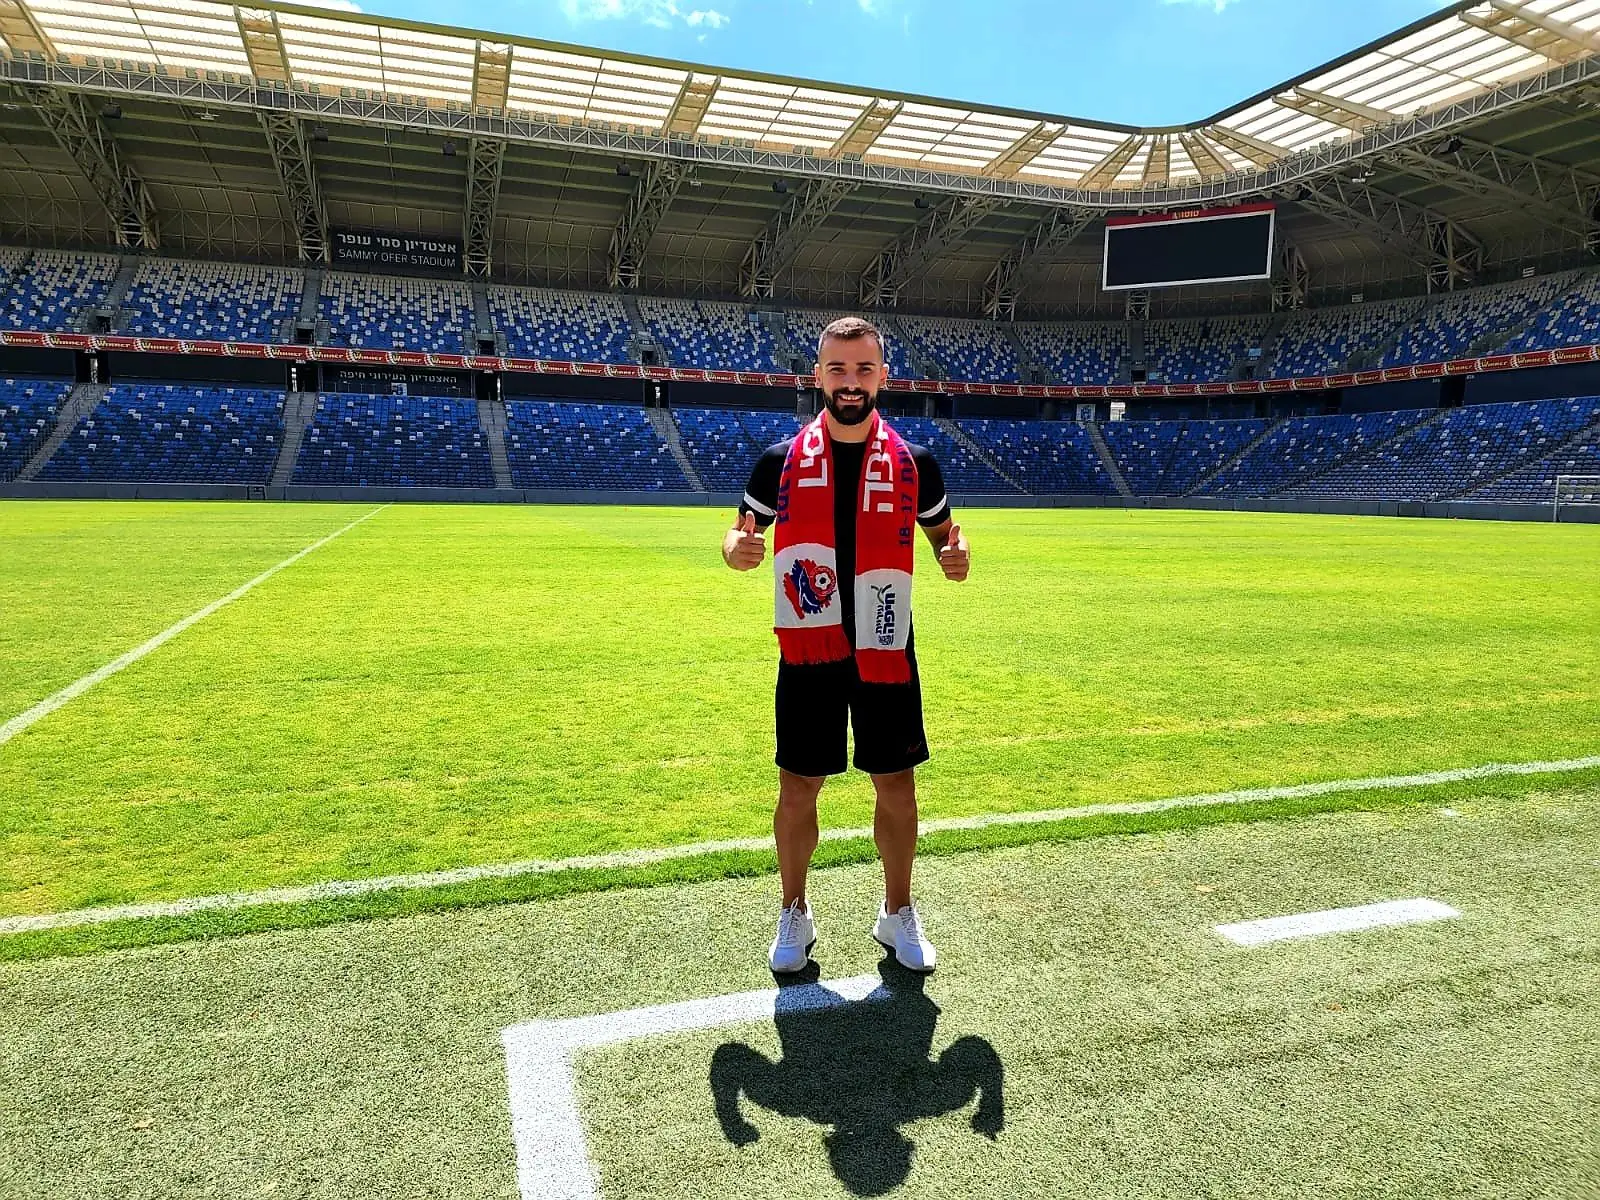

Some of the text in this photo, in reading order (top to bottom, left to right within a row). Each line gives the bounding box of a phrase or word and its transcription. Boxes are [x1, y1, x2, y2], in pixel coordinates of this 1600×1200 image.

[337, 233, 457, 254] אצטדיון סמי עופר
[339, 248, 456, 268] SAMMY OFER STADIUM
[340, 369, 457, 383] האצטדיון העירוני חיפה
[883, 592, 896, 634] חיפה
